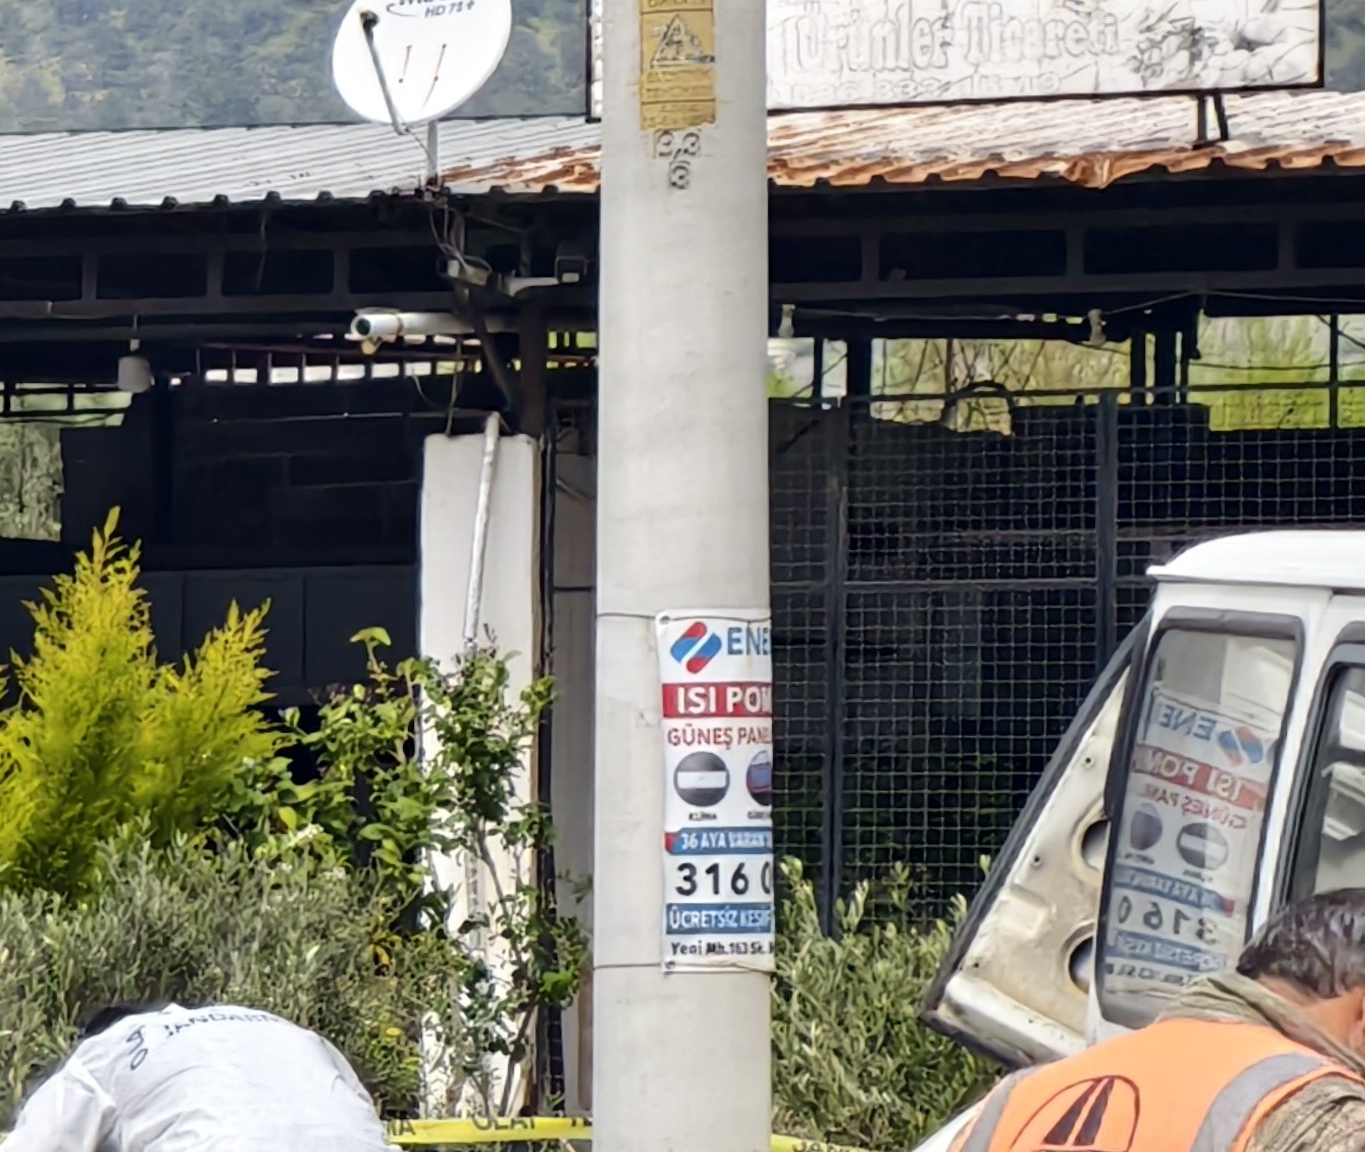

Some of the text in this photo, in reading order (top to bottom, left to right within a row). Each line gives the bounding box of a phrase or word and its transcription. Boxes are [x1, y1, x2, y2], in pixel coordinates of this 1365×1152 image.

[677, 686, 718, 715] ISI
[667, 723, 734, 750] GÜNEŞ
[680, 832, 699, 850] 36
[700, 831, 727, 849] AYA
[669, 905, 739, 929] ÜCRETSİZ
